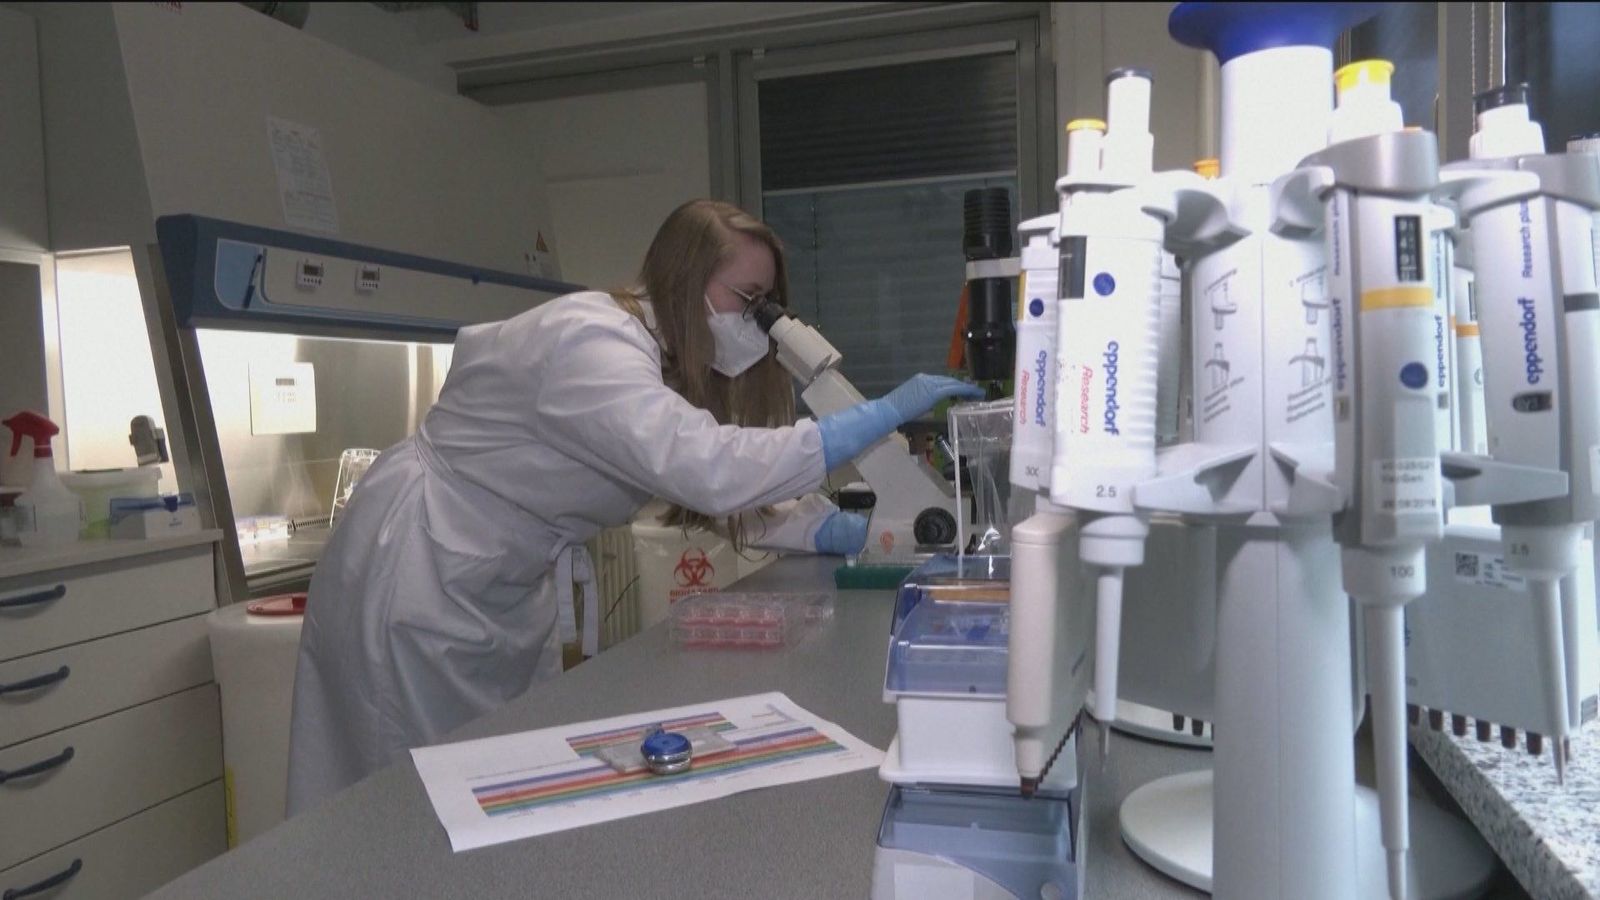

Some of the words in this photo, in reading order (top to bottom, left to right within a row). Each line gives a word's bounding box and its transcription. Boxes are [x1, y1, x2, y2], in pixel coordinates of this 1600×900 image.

[1435, 314, 1446, 387] eppendorf
[1518, 298, 1544, 385] eppendorf
[1019, 370, 1030, 425] Research
[1035, 350, 1047, 427] eppendorf
[1079, 365, 1093, 435] Research
[1103, 340, 1119, 436] eppendorf
